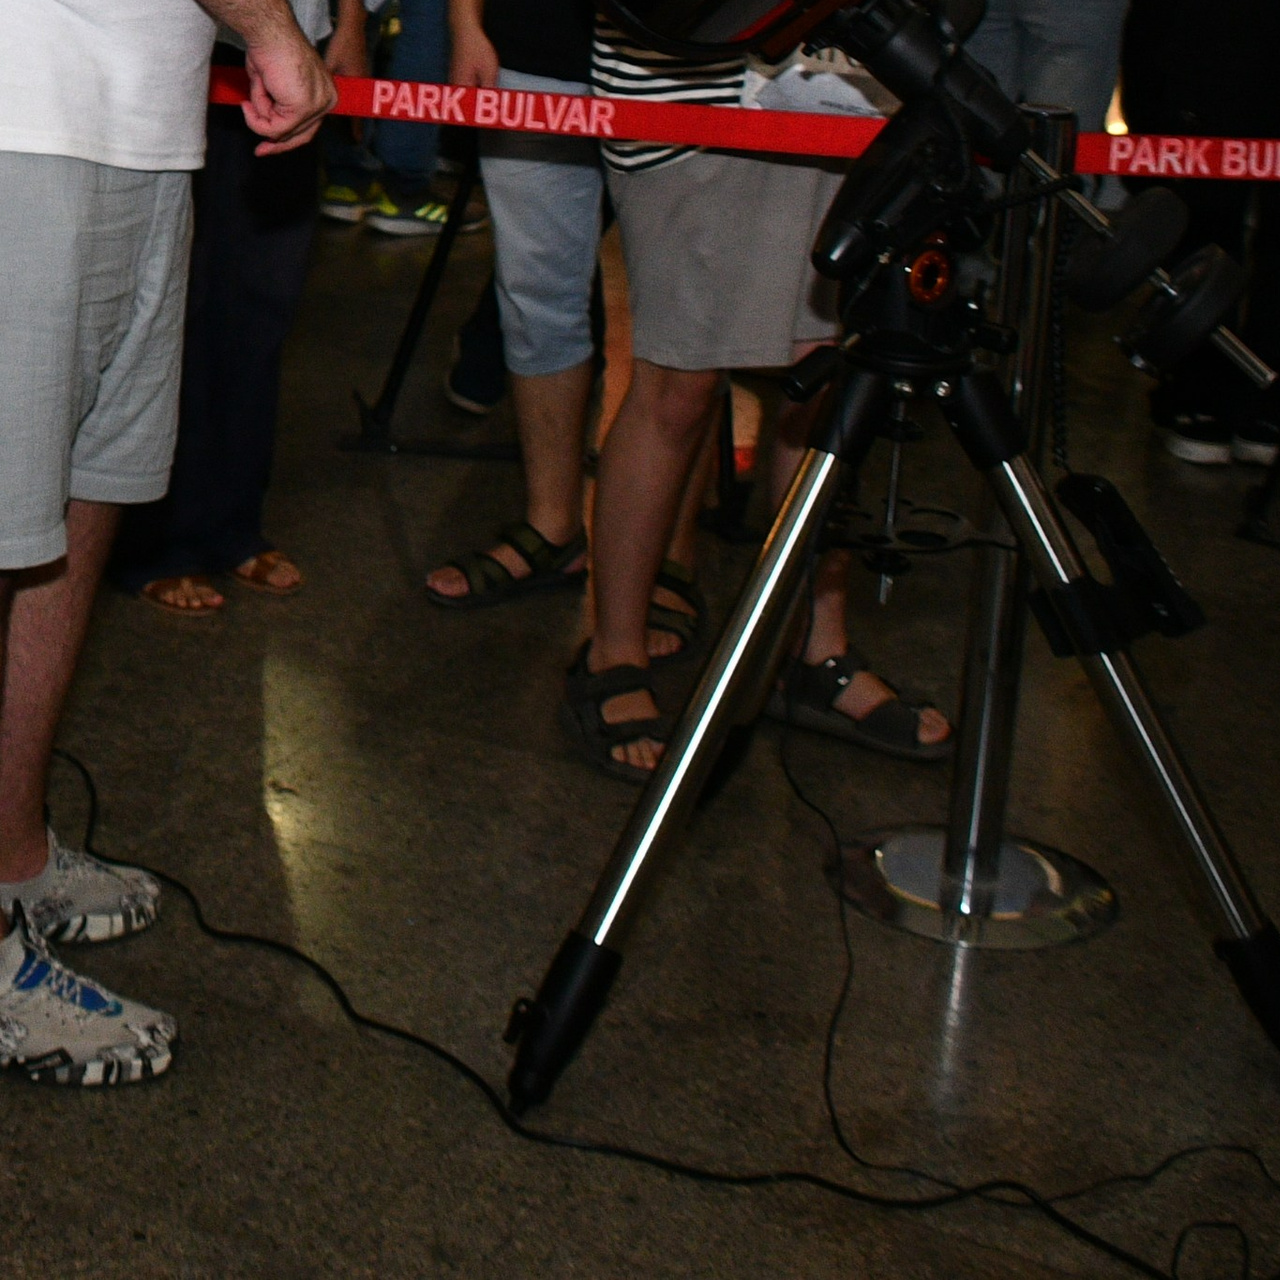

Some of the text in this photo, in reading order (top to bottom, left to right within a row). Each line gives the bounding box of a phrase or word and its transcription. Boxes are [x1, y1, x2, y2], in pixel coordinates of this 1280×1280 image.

[372, 80, 616, 136] PARK BULVAR
[1108, 136, 1212, 175] PARK
